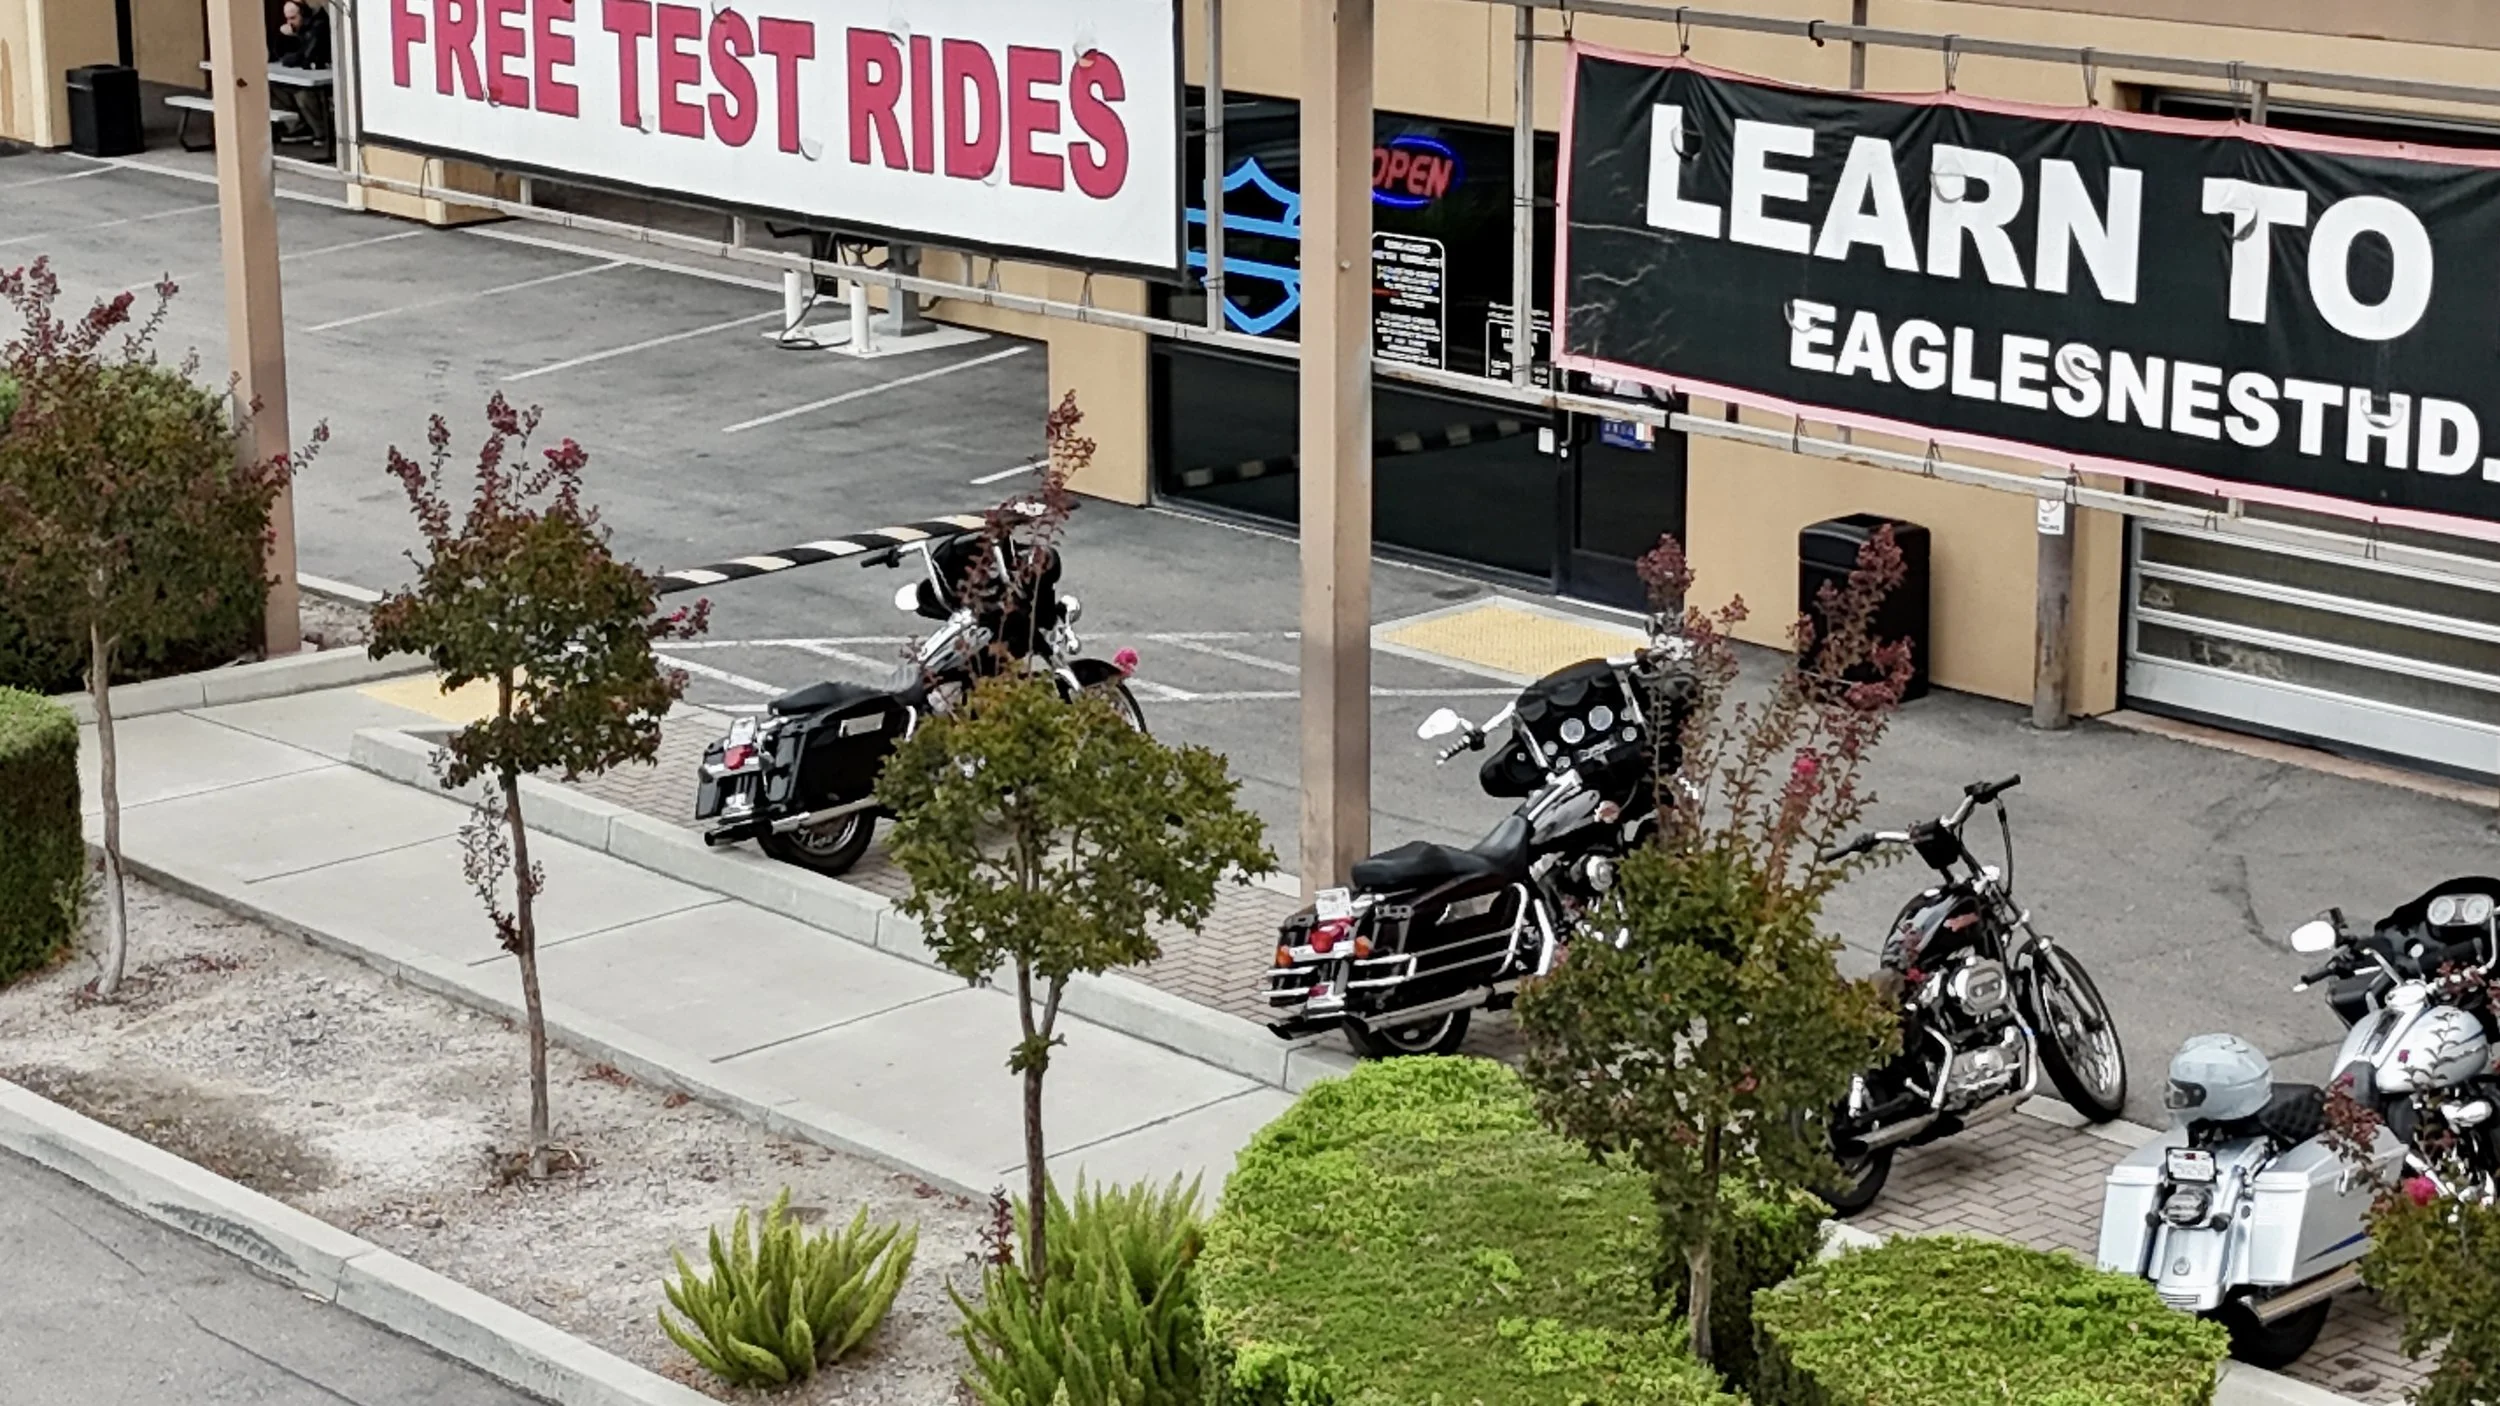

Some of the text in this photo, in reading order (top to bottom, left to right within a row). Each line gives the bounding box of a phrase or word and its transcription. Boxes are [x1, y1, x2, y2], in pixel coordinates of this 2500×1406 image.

[389, 0, 1130, 200] FREE TEST RIDES
[1372, 147, 1454, 198] OPEN
[1645, 103, 2434, 341] LEARN TO
[1788, 299, 2500, 482] EAGLESNESTHD.
